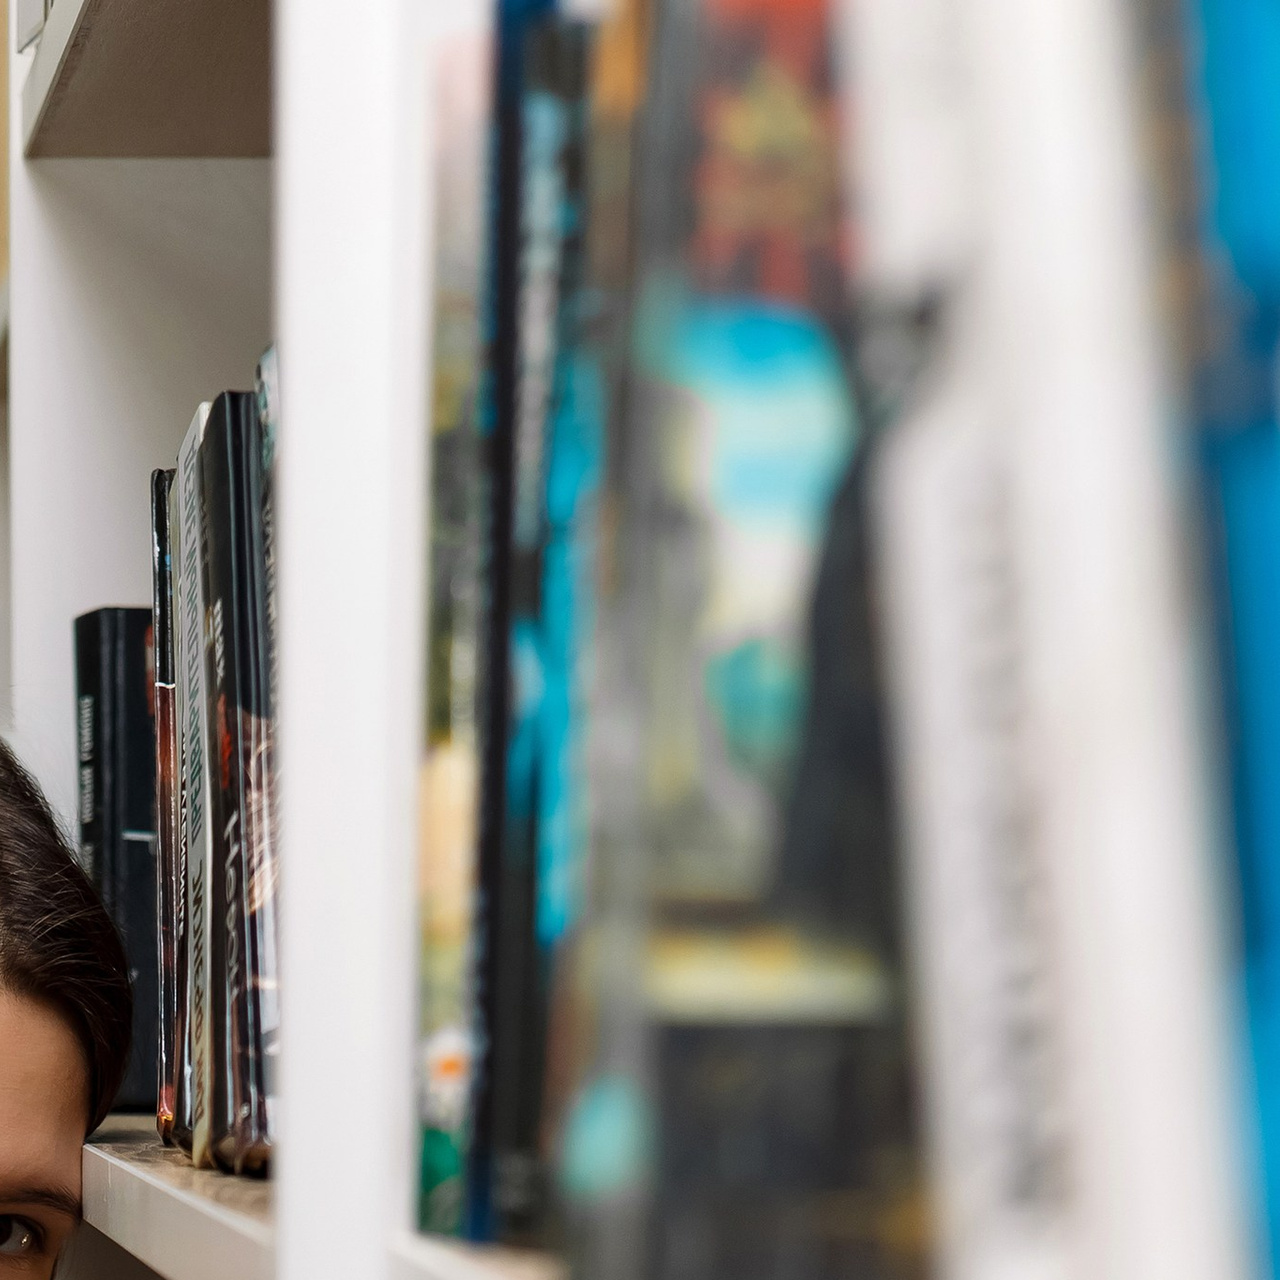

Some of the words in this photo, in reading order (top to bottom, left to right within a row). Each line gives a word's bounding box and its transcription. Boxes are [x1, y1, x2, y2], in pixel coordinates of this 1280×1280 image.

[183, 434, 197, 542] ЗАЕЗД
[185, 542, 203, 847] ПРЕДВАРИТЕЛЬНЫЙ
[192, 858, 204, 1044] ФРЭНСИС
